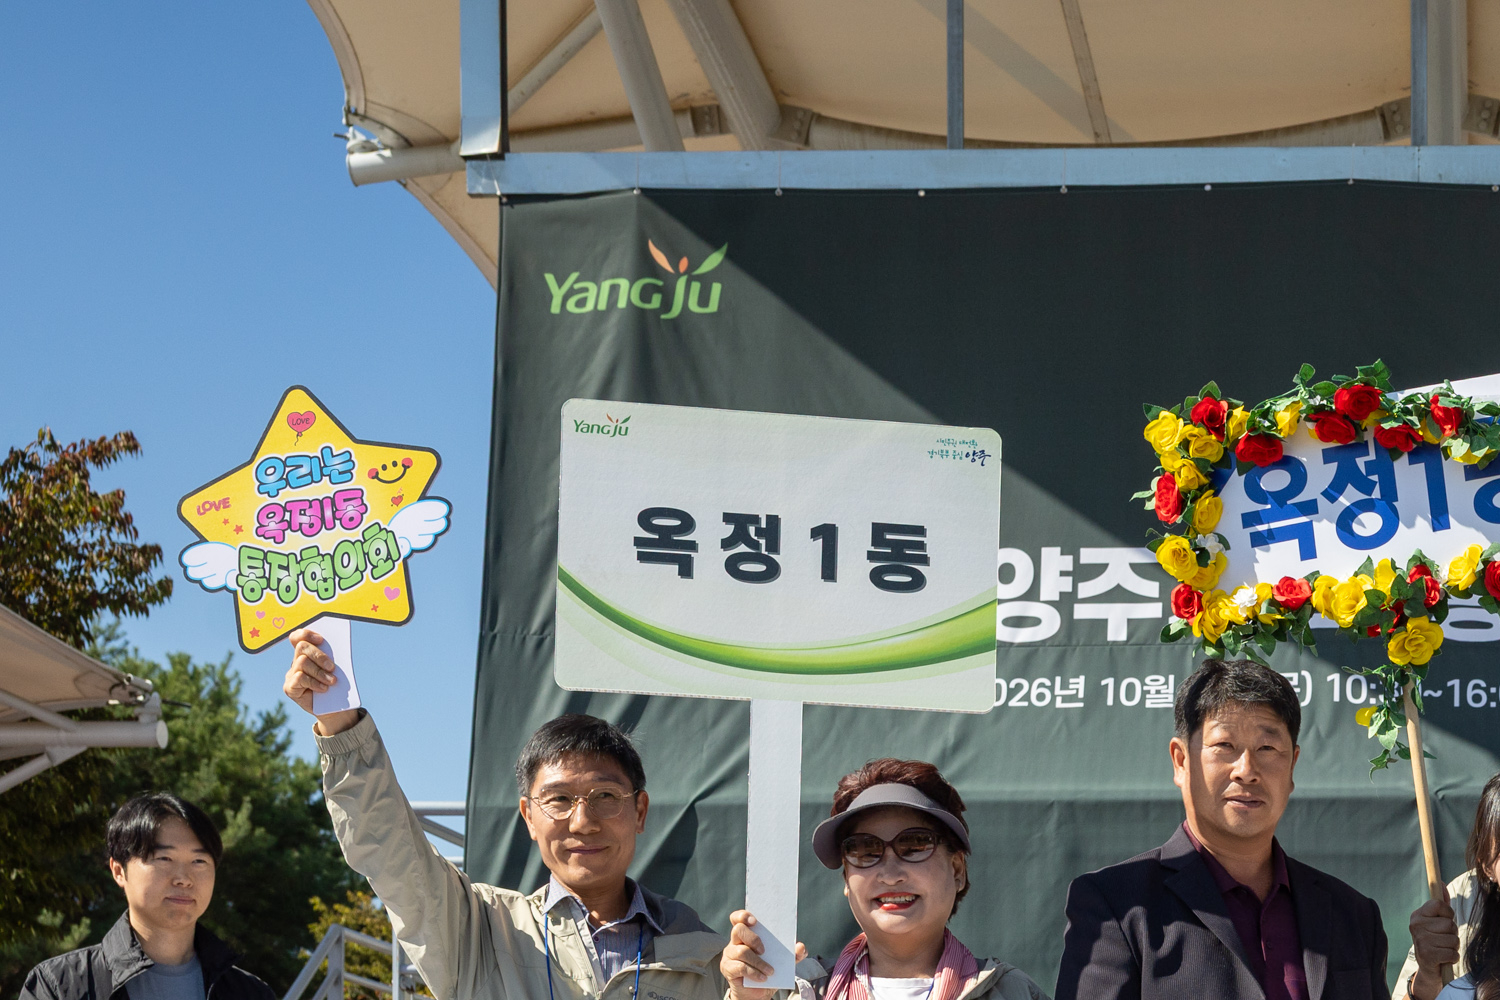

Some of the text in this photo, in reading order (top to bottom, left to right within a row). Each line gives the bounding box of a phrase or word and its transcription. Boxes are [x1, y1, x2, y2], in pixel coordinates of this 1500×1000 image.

[291, 417, 311, 426] LOVE
[255, 446, 356, 498] 우리는
[965, 449, 992, 467] 양주
[196, 497, 232, 516] LOVE
[256, 488, 368, 544] 옥정1동
[237, 521, 401, 603] 통장협의회
[633, 506, 931, 593] 옥정1동
[997, 546, 1172, 643] 양주
[995, 675, 1086, 708] 026년
[1101, 674, 1175, 708] 10월
